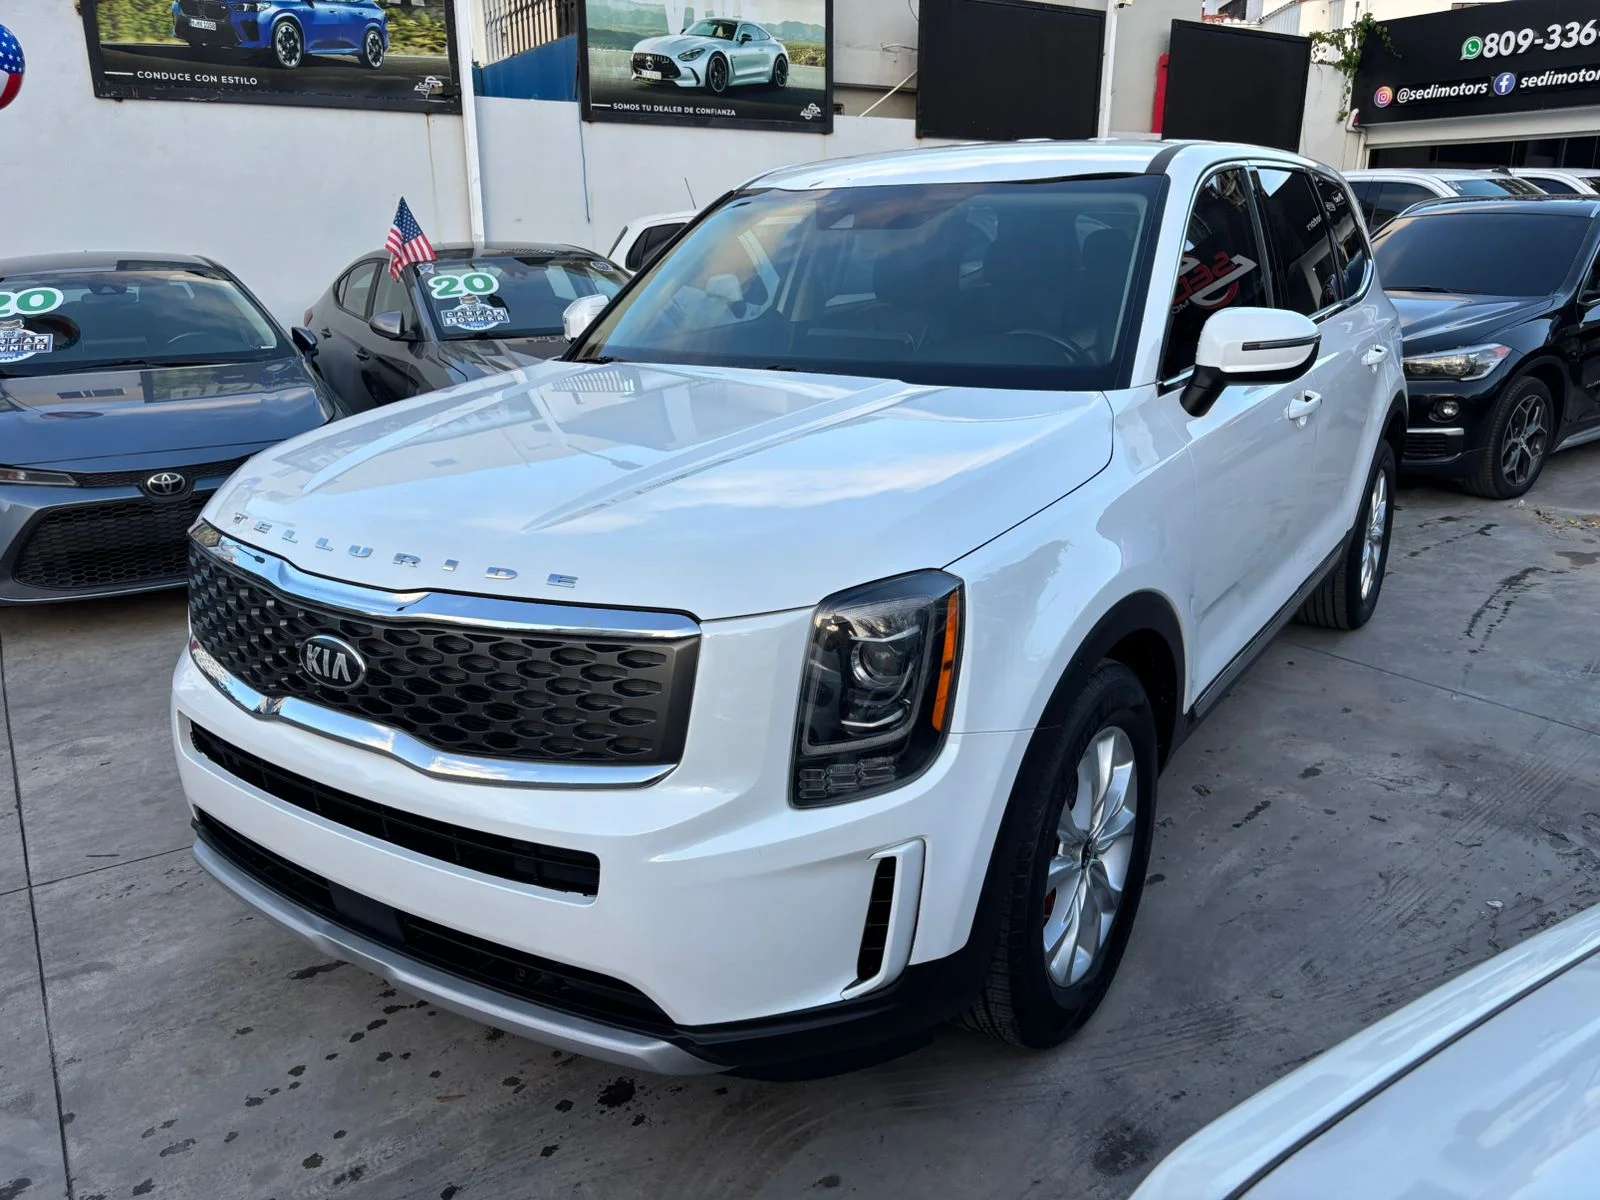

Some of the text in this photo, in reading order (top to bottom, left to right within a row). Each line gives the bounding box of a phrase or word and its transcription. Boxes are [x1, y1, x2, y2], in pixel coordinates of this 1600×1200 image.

[137, 71, 258, 85] CONDUCE CON ESTILO
[1397, 81, 1488, 103] @sedimotors
[613, 102, 640, 111] SOMOS
[654, 105, 682, 114] DEALER
[684, 106, 694, 114] DE
[696, 107, 736, 116] CONFIANZA
[430, 273, 497, 298] 20
[233, 511, 579, 588] TELLURIDE
[306, 644, 352, 683] KIA
